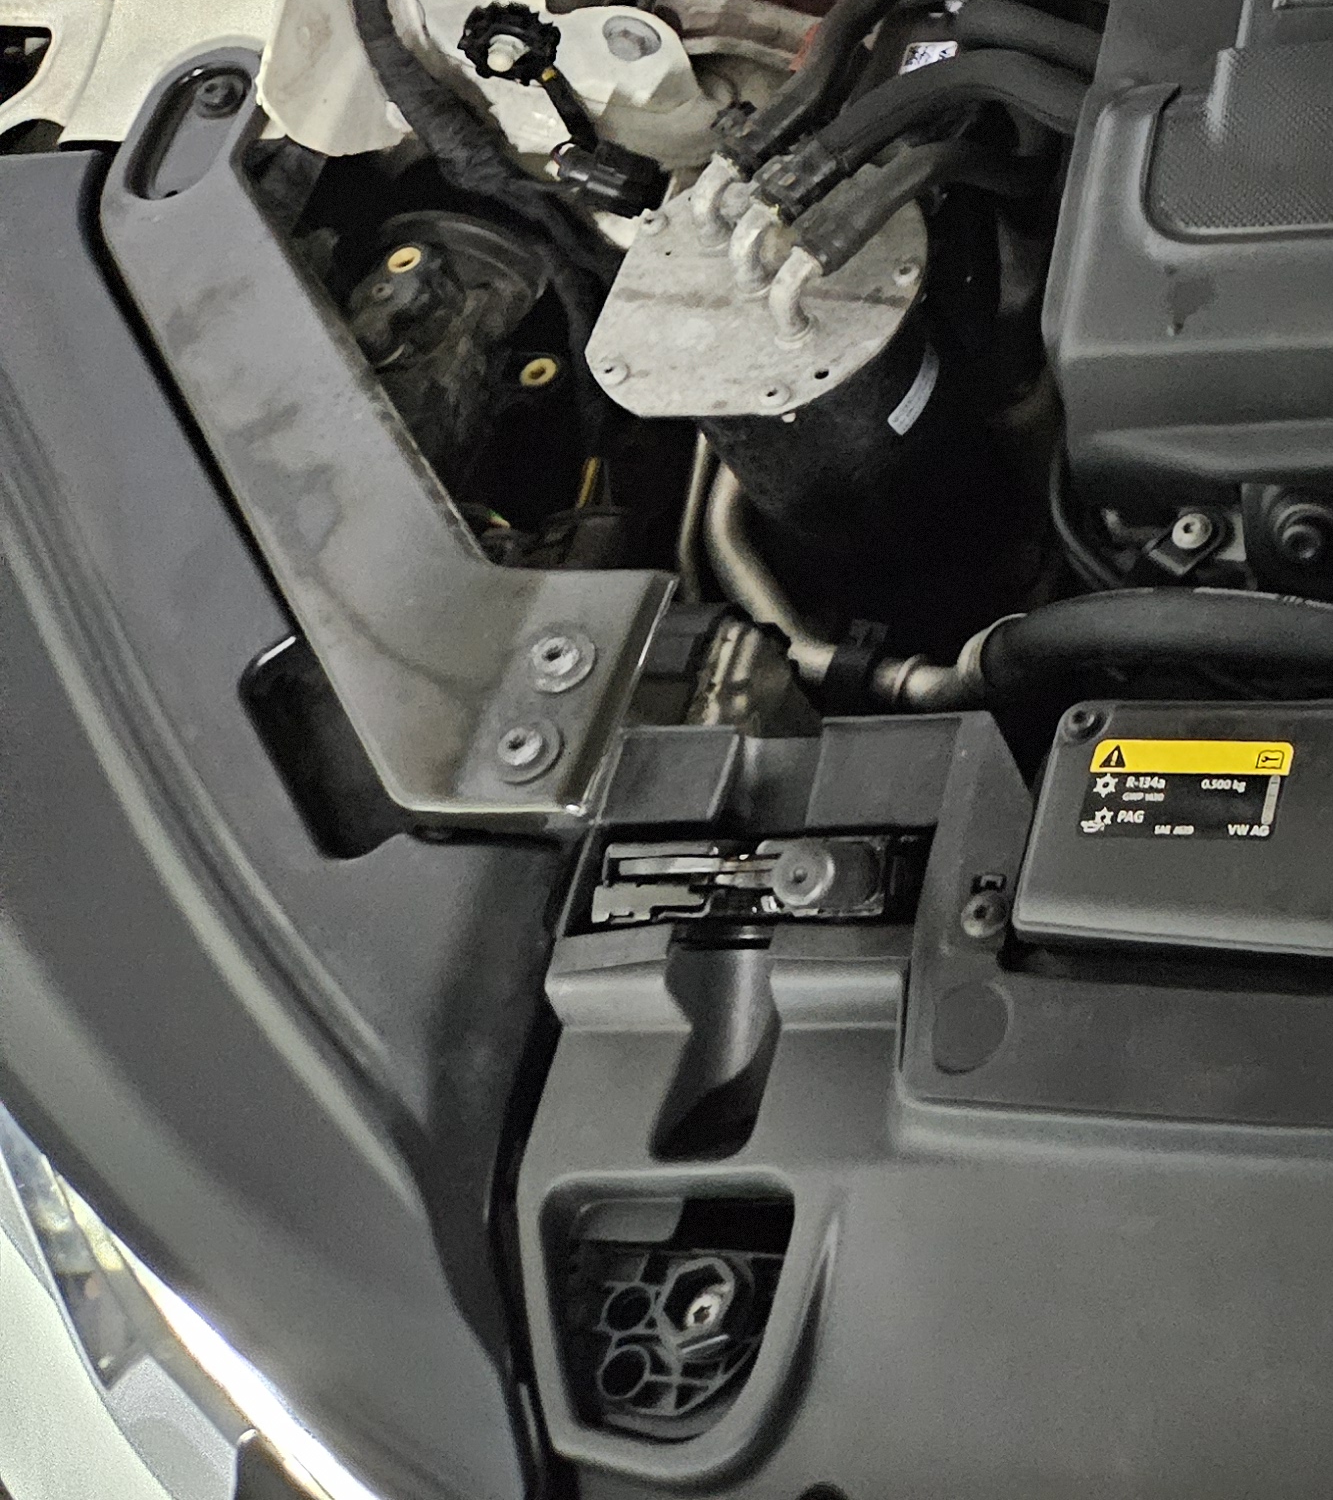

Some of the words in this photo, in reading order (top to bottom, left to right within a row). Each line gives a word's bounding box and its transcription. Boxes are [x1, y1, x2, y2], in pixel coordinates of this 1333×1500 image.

[1126, 776, 1166, 789] R-134a
[1117, 810, 1145, 823] PAG
[1228, 824, 1249, 836] VW
[1250, 824, 1270, 836] AG
